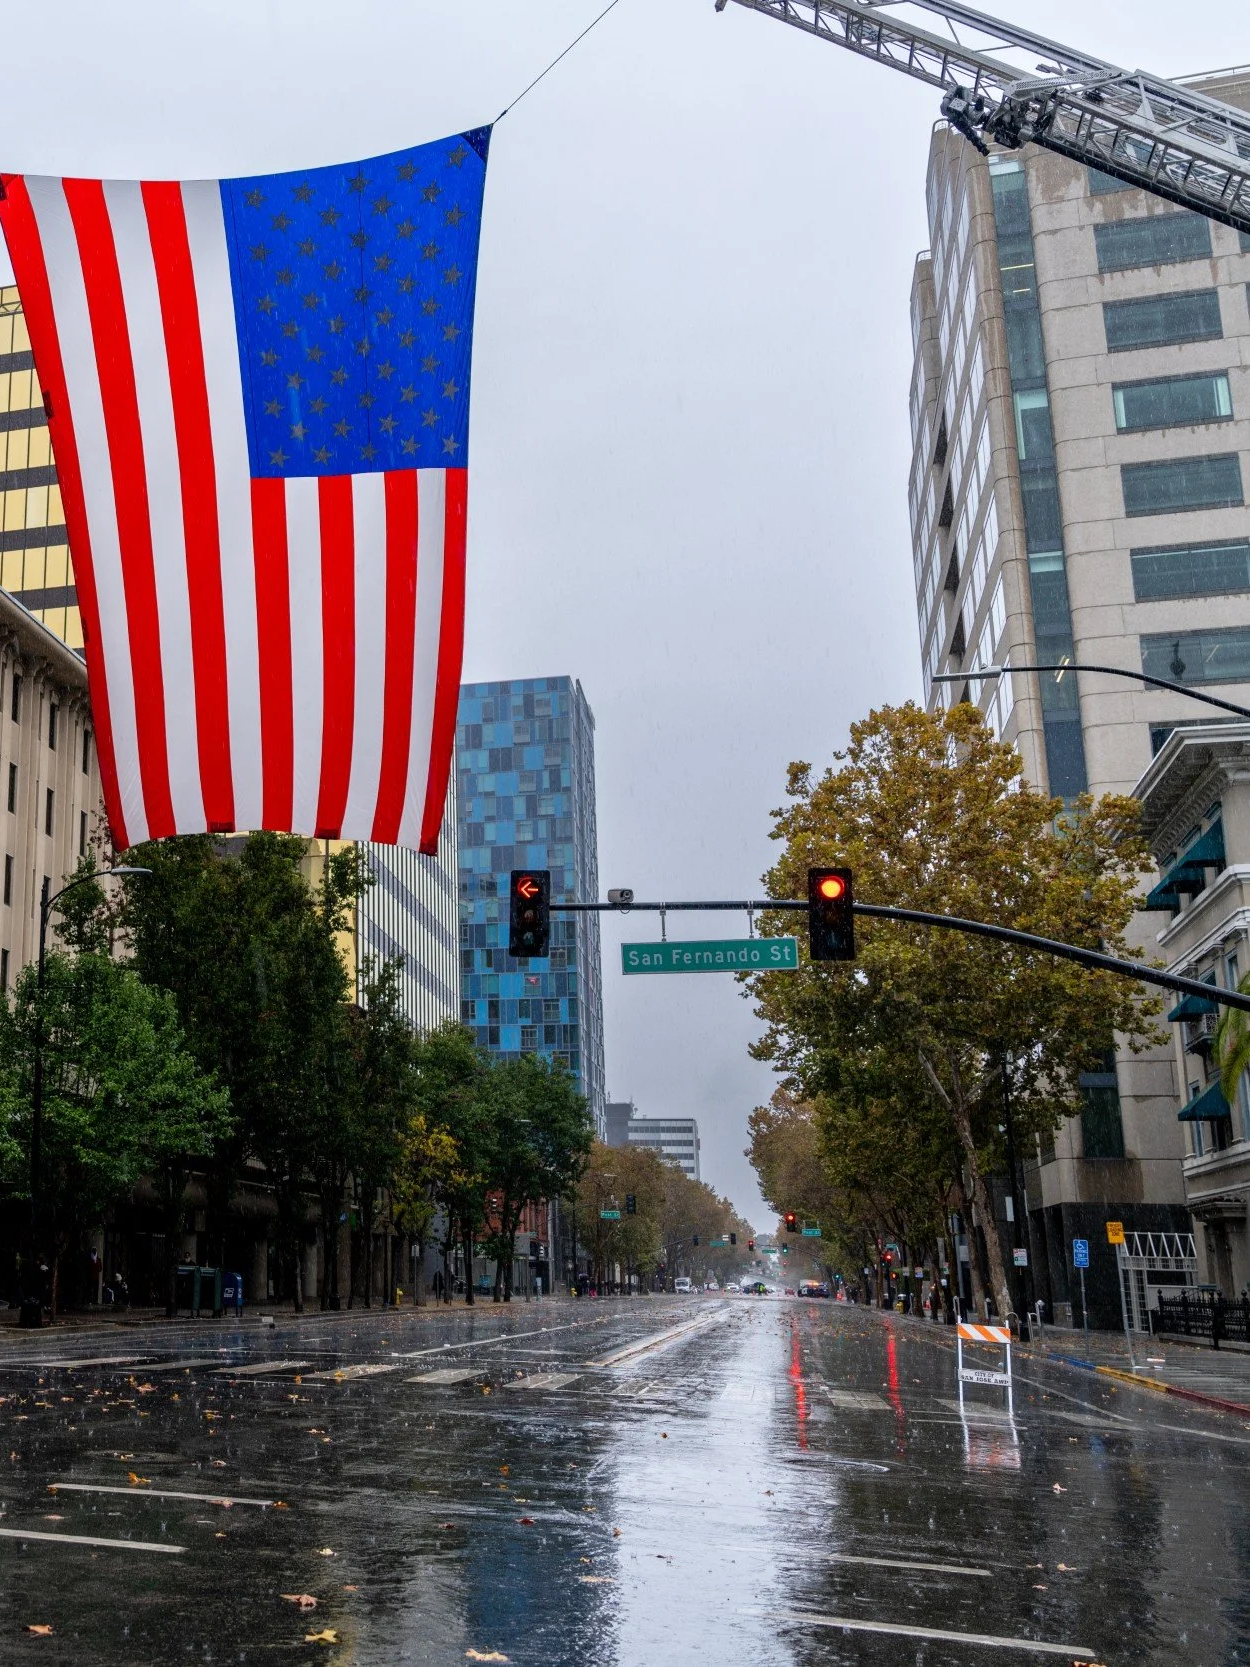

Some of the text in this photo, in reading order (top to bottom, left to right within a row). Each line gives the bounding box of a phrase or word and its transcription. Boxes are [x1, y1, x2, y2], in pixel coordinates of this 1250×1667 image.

[628, 945, 791, 966] San Fernando St
